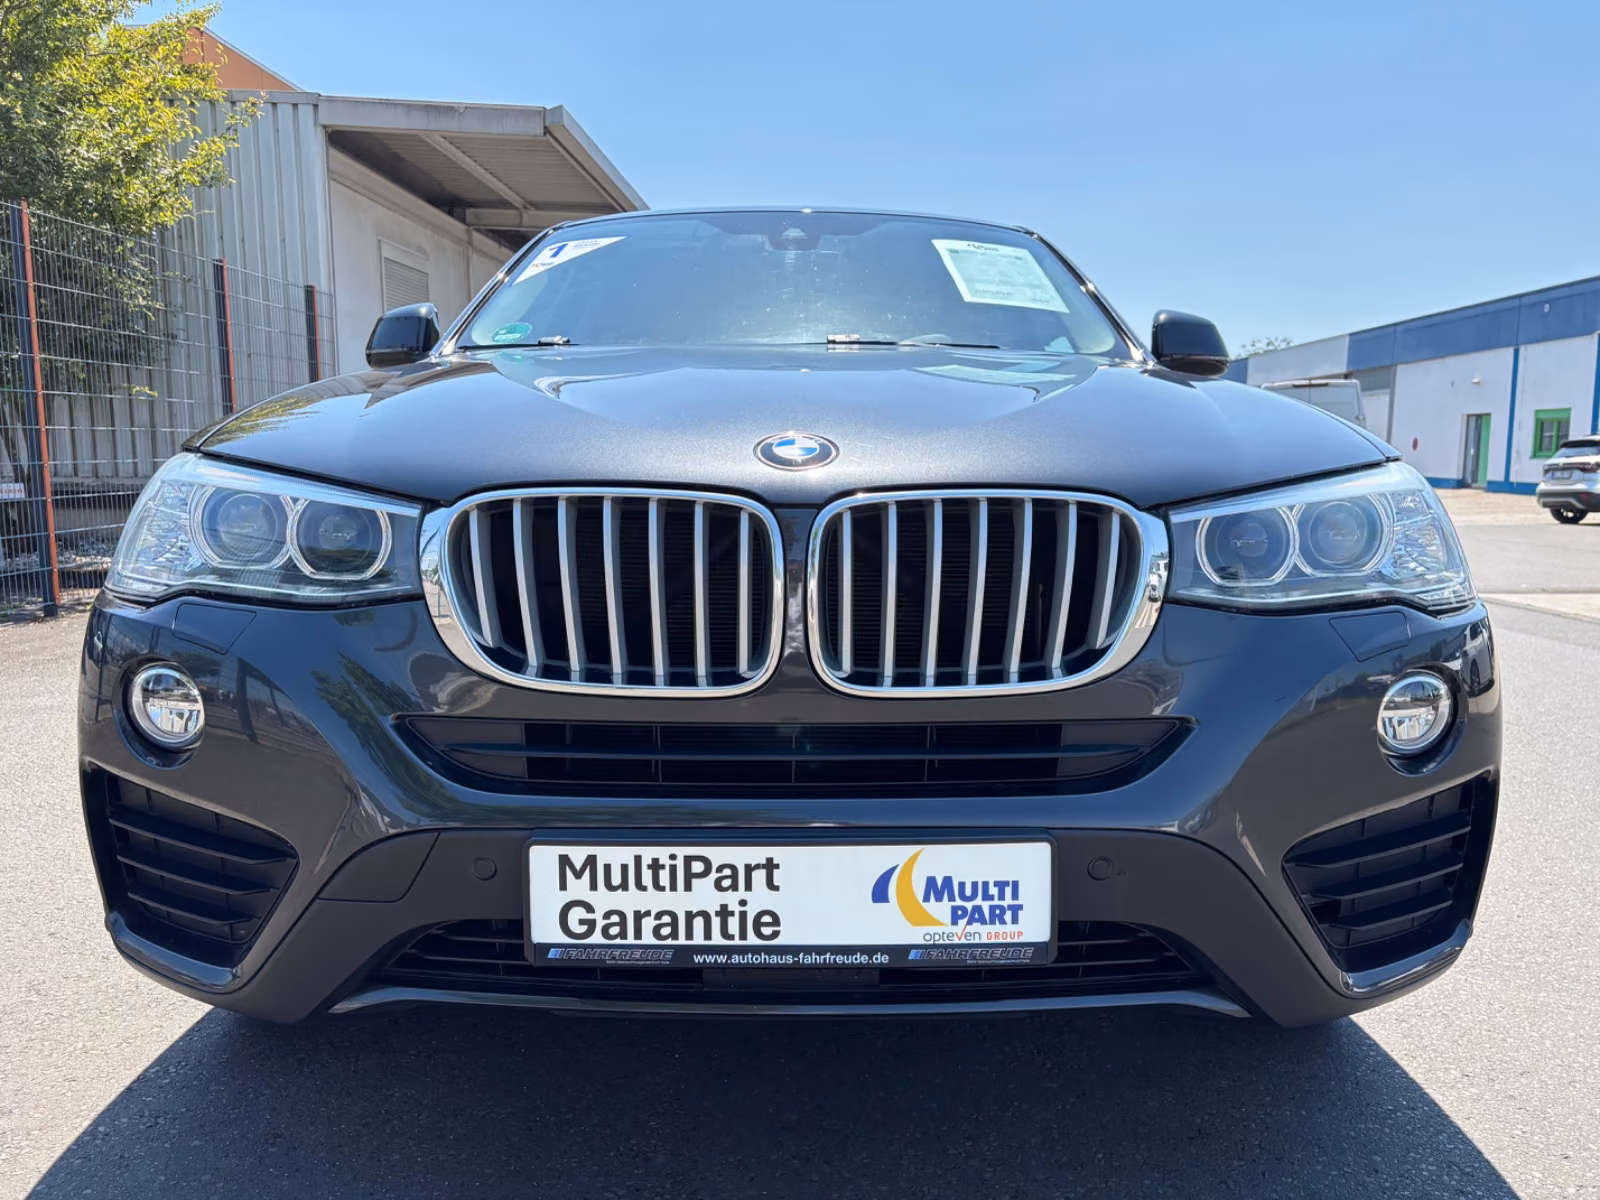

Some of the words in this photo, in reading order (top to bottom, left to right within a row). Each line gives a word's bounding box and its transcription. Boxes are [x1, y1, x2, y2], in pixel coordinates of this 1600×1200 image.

[558, 853, 781, 893] MultiPart
[922, 875, 1020, 903] MULTI
[558, 898, 782, 942] Garantie
[950, 904, 1024, 926] PART
[922, 930, 982, 944] opteven
[986, 930, 1024, 941] GROUP
[563, 948, 675, 960] FAHRFREUDE
[693, 951, 890, 965] www.autohaus-fahrfreude.de
[925, 947, 1035, 960] FAHRFREUDE
